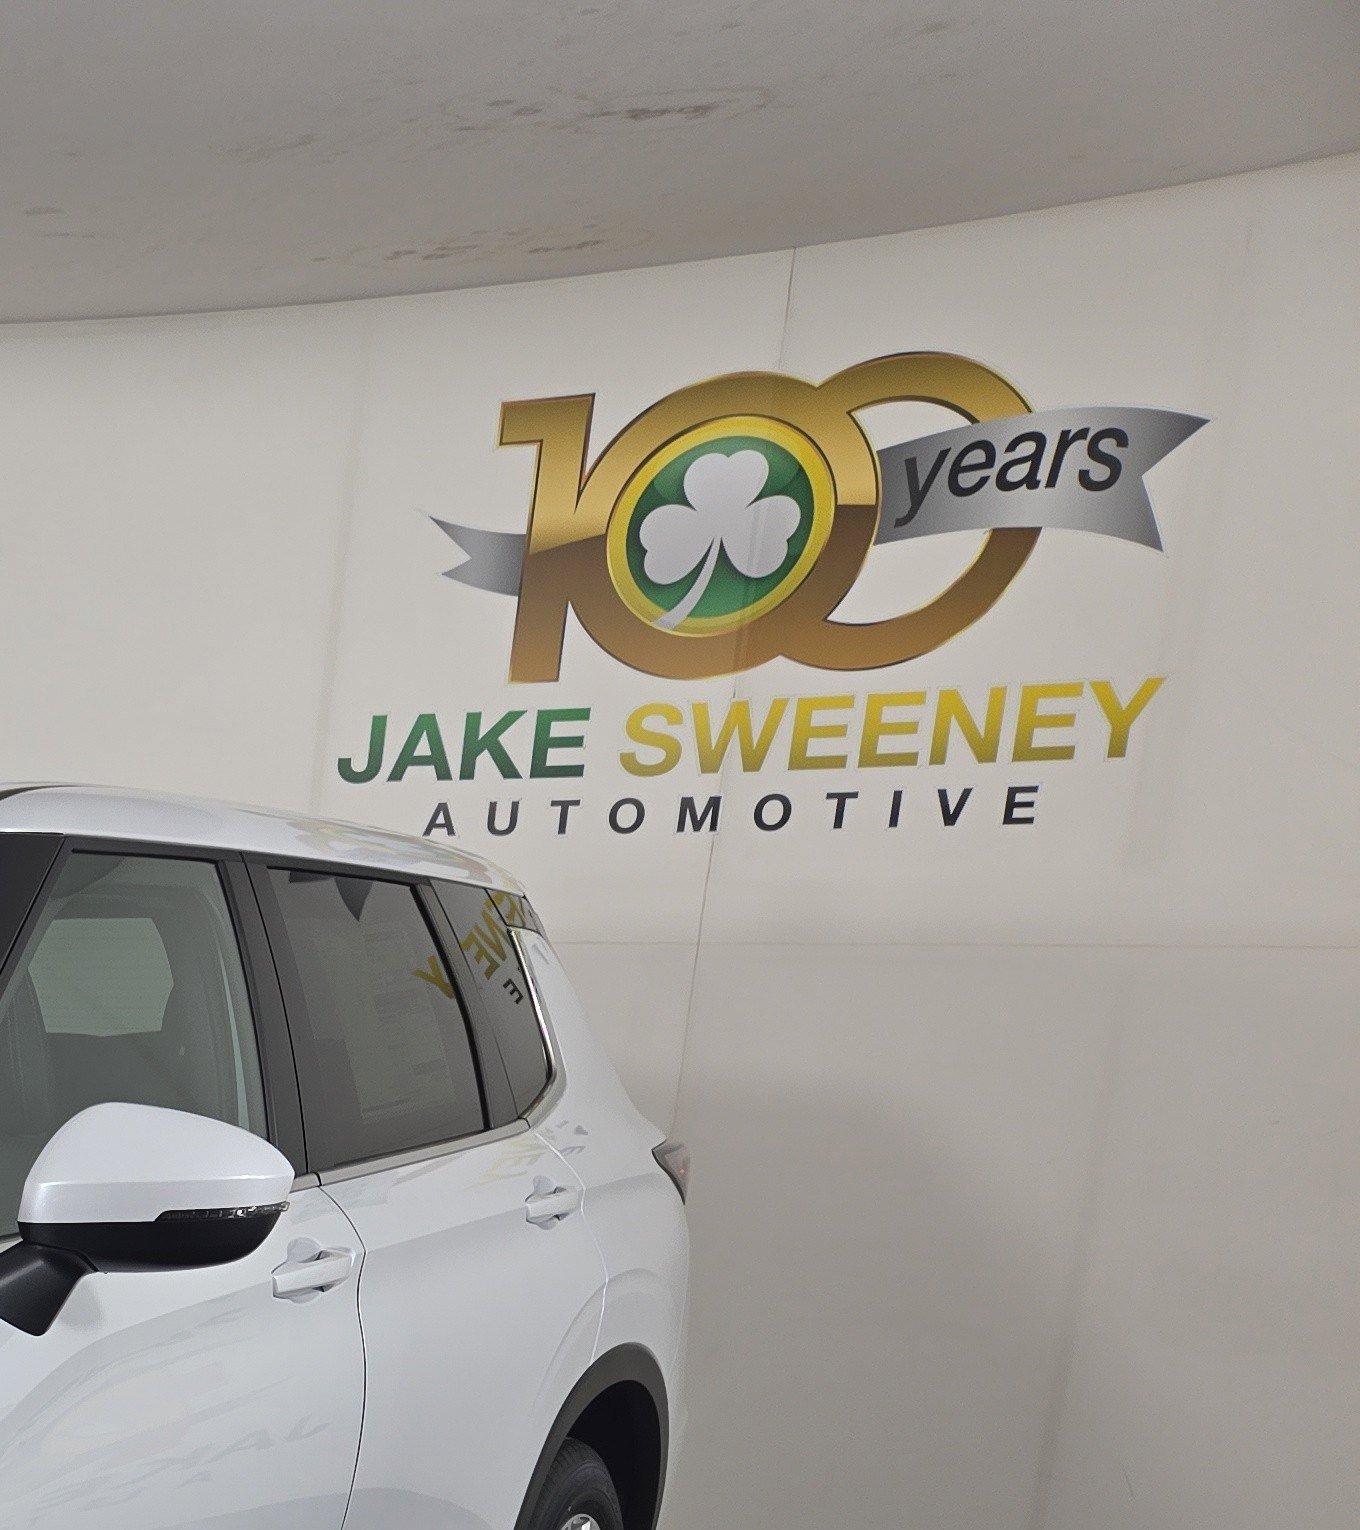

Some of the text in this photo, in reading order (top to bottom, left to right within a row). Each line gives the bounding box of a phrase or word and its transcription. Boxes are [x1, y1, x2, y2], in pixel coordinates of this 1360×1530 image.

[498, 351, 1129, 684] 100 years
[337, 677, 1166, 784] JAKE SWEENEY
[423, 785, 1039, 837] AUTOMOTIVE
